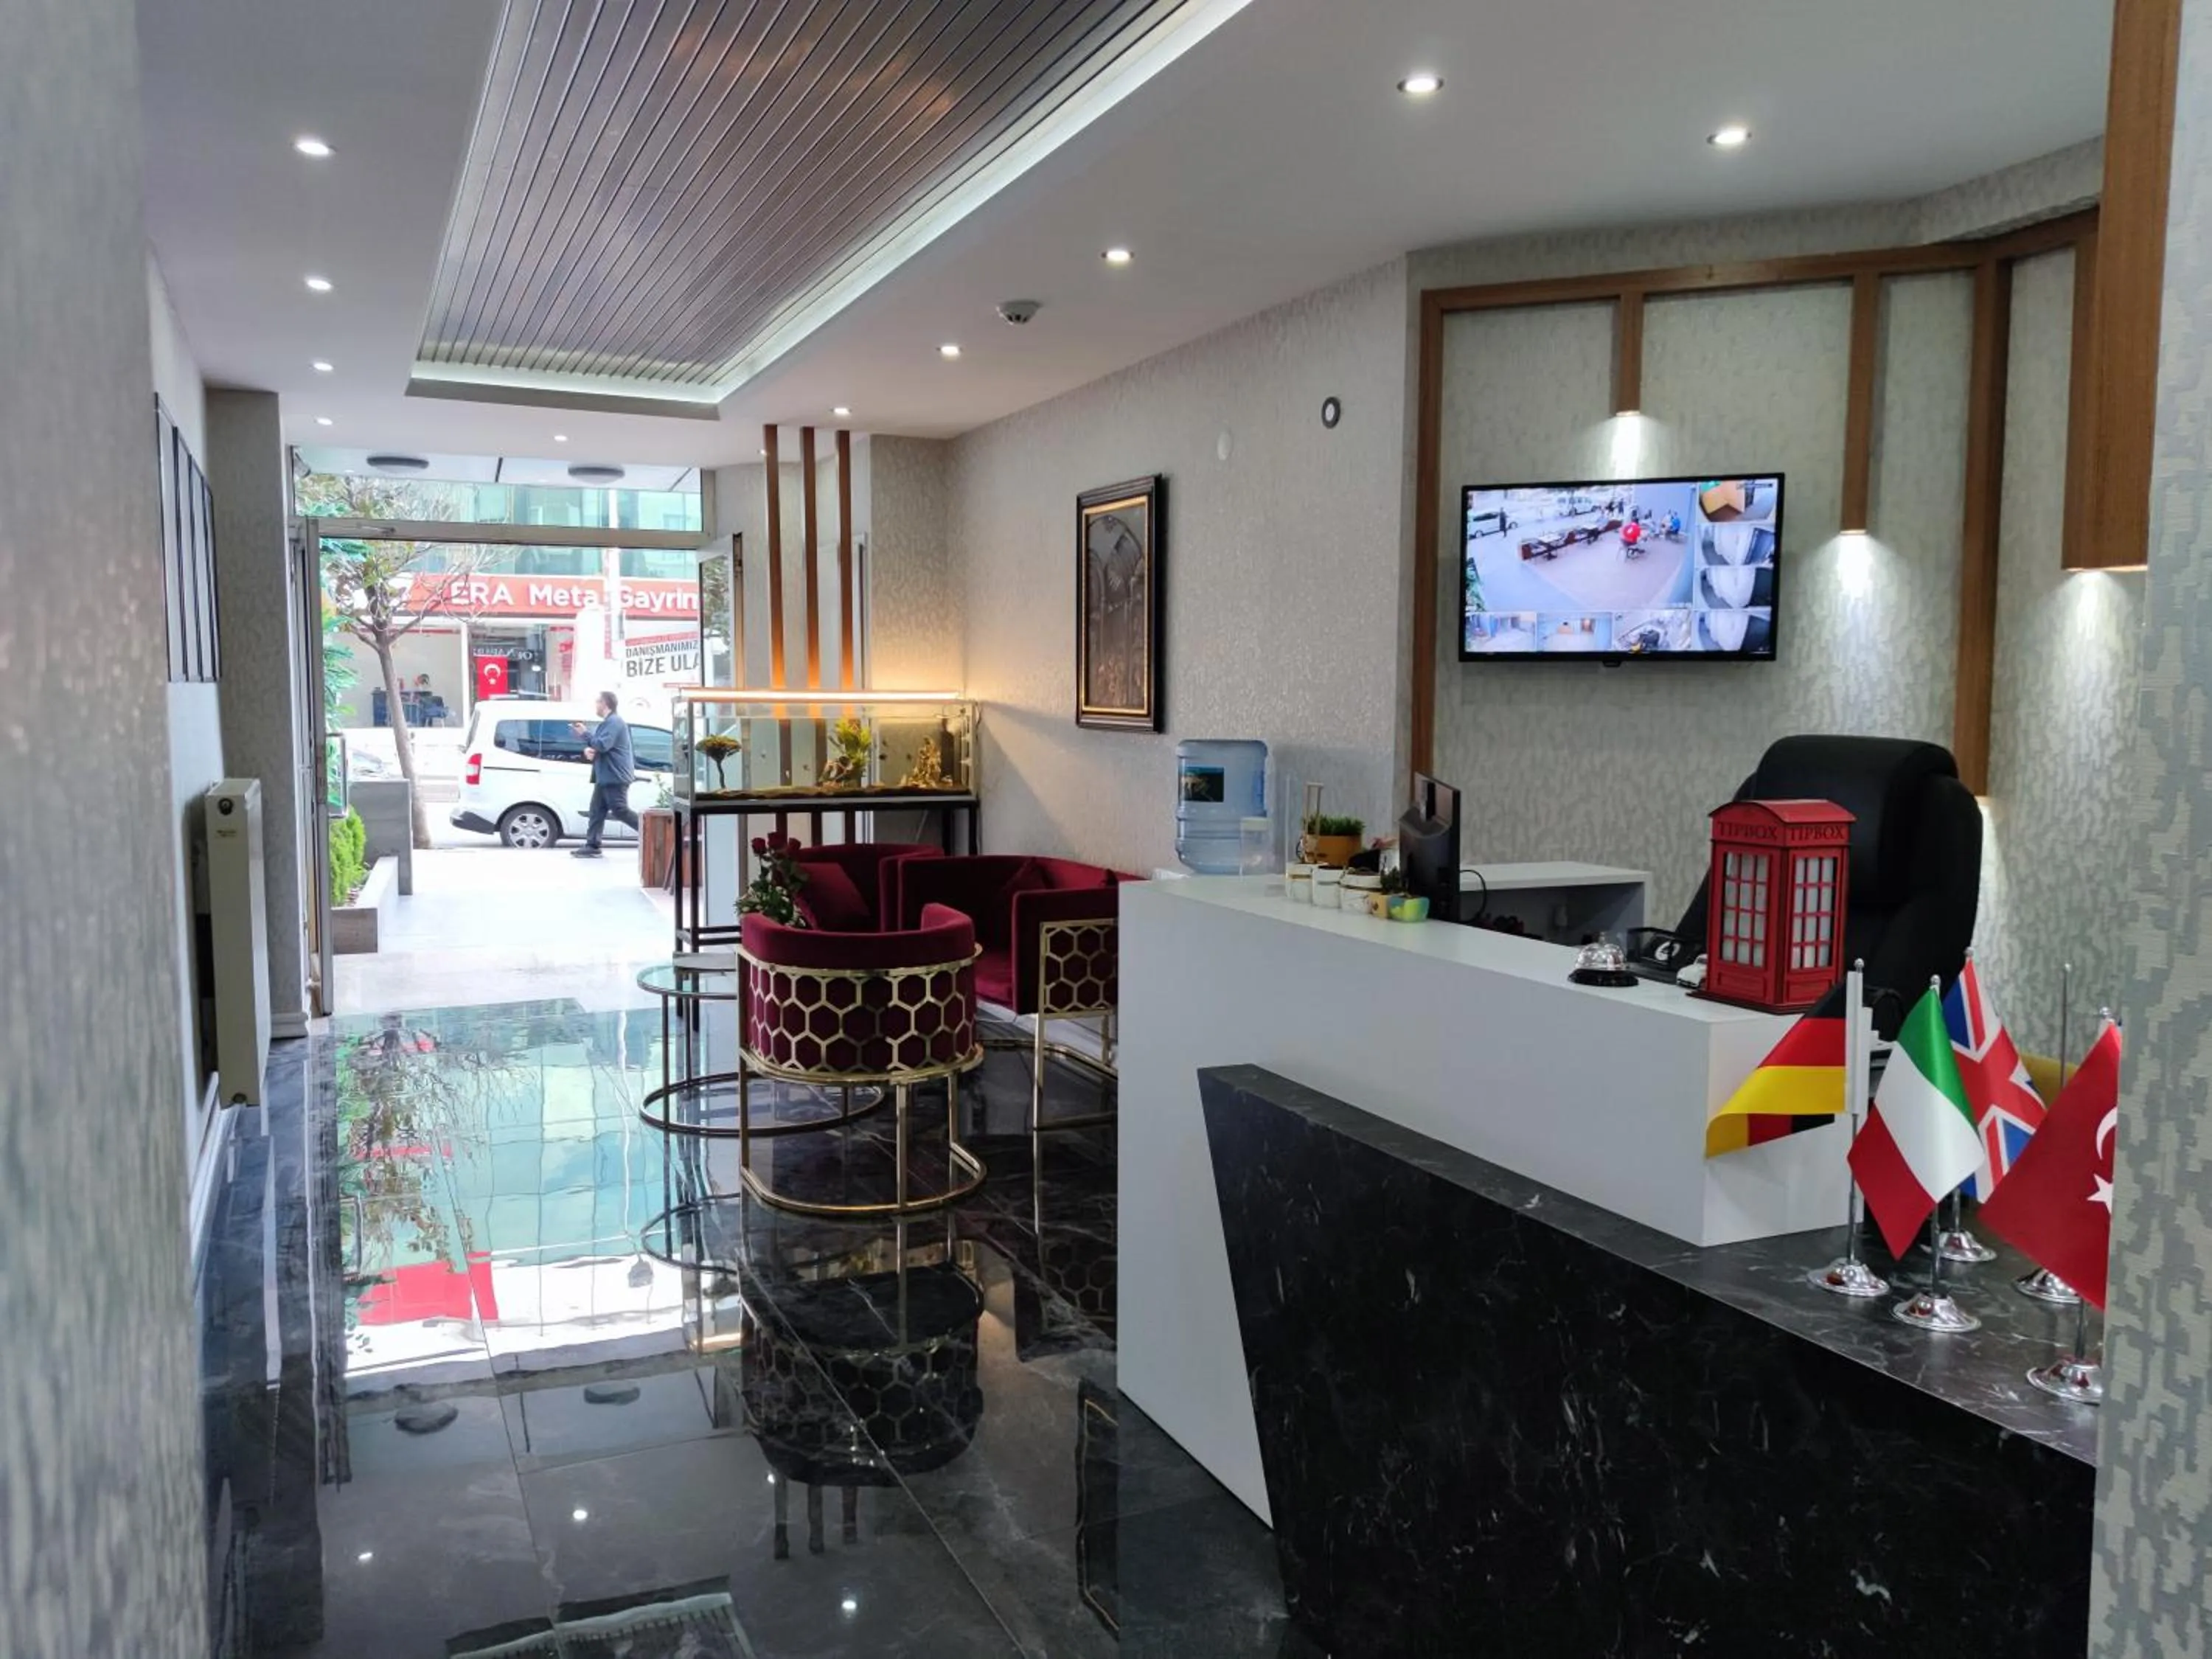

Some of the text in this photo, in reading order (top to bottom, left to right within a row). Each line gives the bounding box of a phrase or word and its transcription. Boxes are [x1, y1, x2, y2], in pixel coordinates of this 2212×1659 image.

[451, 581, 514, 606] ERA
[626, 656, 665, 678] BİZE
[1717, 821, 1778, 841] TIPBOX
[1789, 825, 1845, 841] TIPBOX
